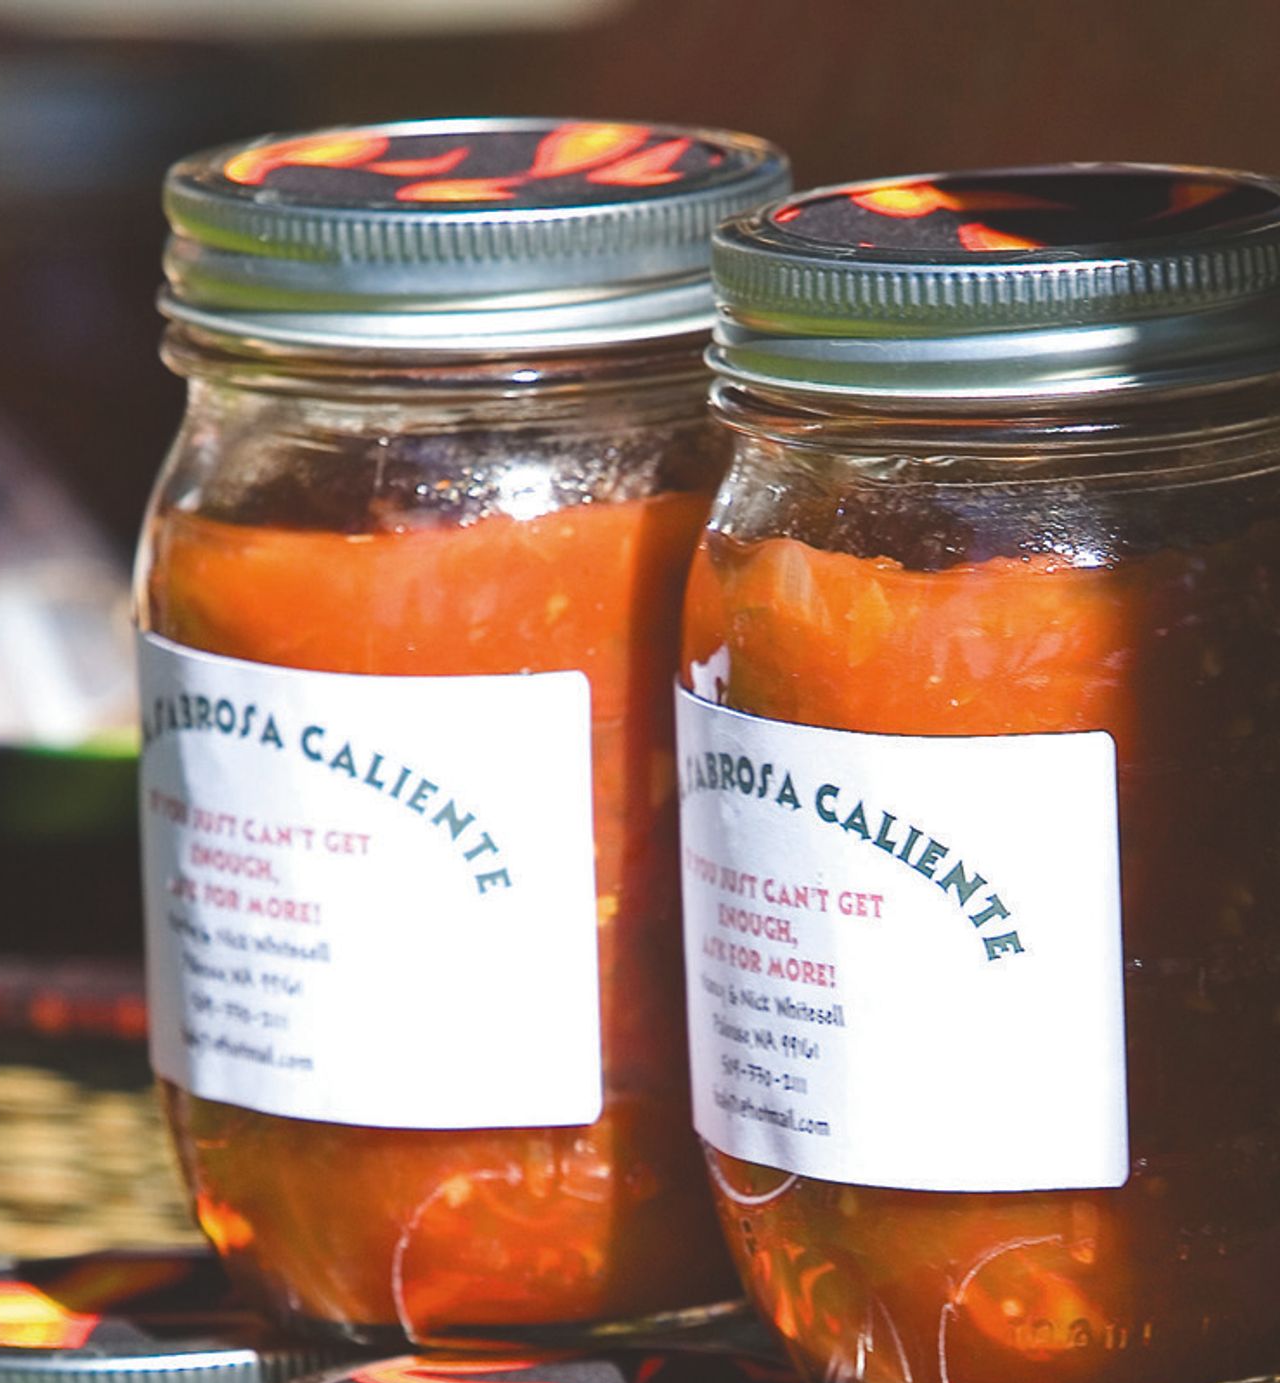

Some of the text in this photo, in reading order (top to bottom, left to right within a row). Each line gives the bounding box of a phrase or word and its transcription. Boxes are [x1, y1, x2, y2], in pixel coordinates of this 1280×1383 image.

[300, 725, 513, 896] CALIENTE
[243, 818, 315, 851] CAN'T
[324, 829, 371, 856] GET
[814, 784, 1025, 962] CALIENTE
[763, 878, 829, 913] CAN'T
[838, 889, 885, 919] GET
[718, 902, 798, 949] ENOUGH,
[767, 953, 837, 989] MORE!
